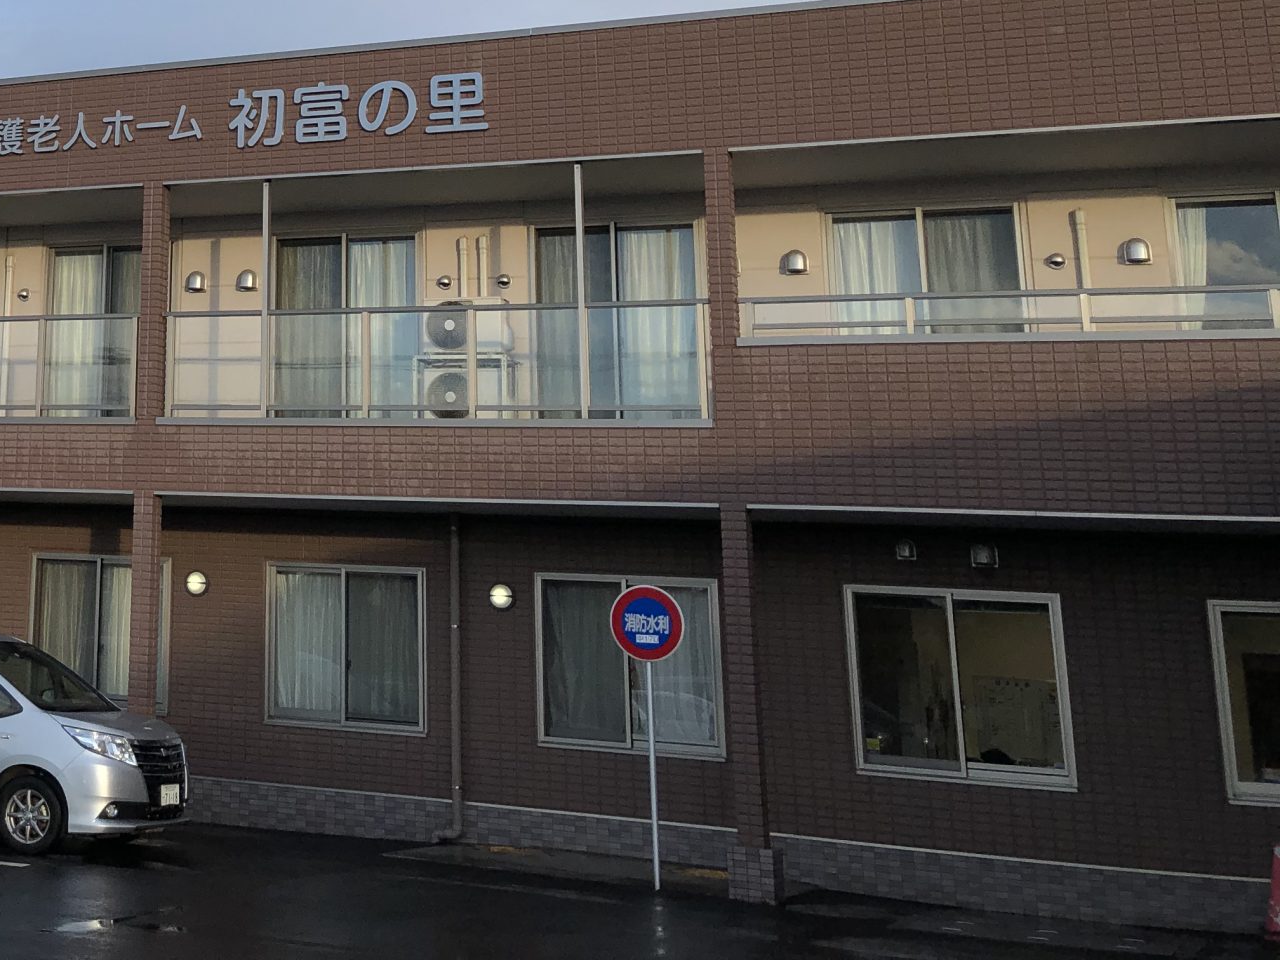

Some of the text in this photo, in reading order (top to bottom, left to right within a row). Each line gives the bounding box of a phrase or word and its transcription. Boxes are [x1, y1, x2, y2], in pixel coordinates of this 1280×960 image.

[228, 71, 489, 149] 初富の里
[624, 613, 669, 635] 消防水利
